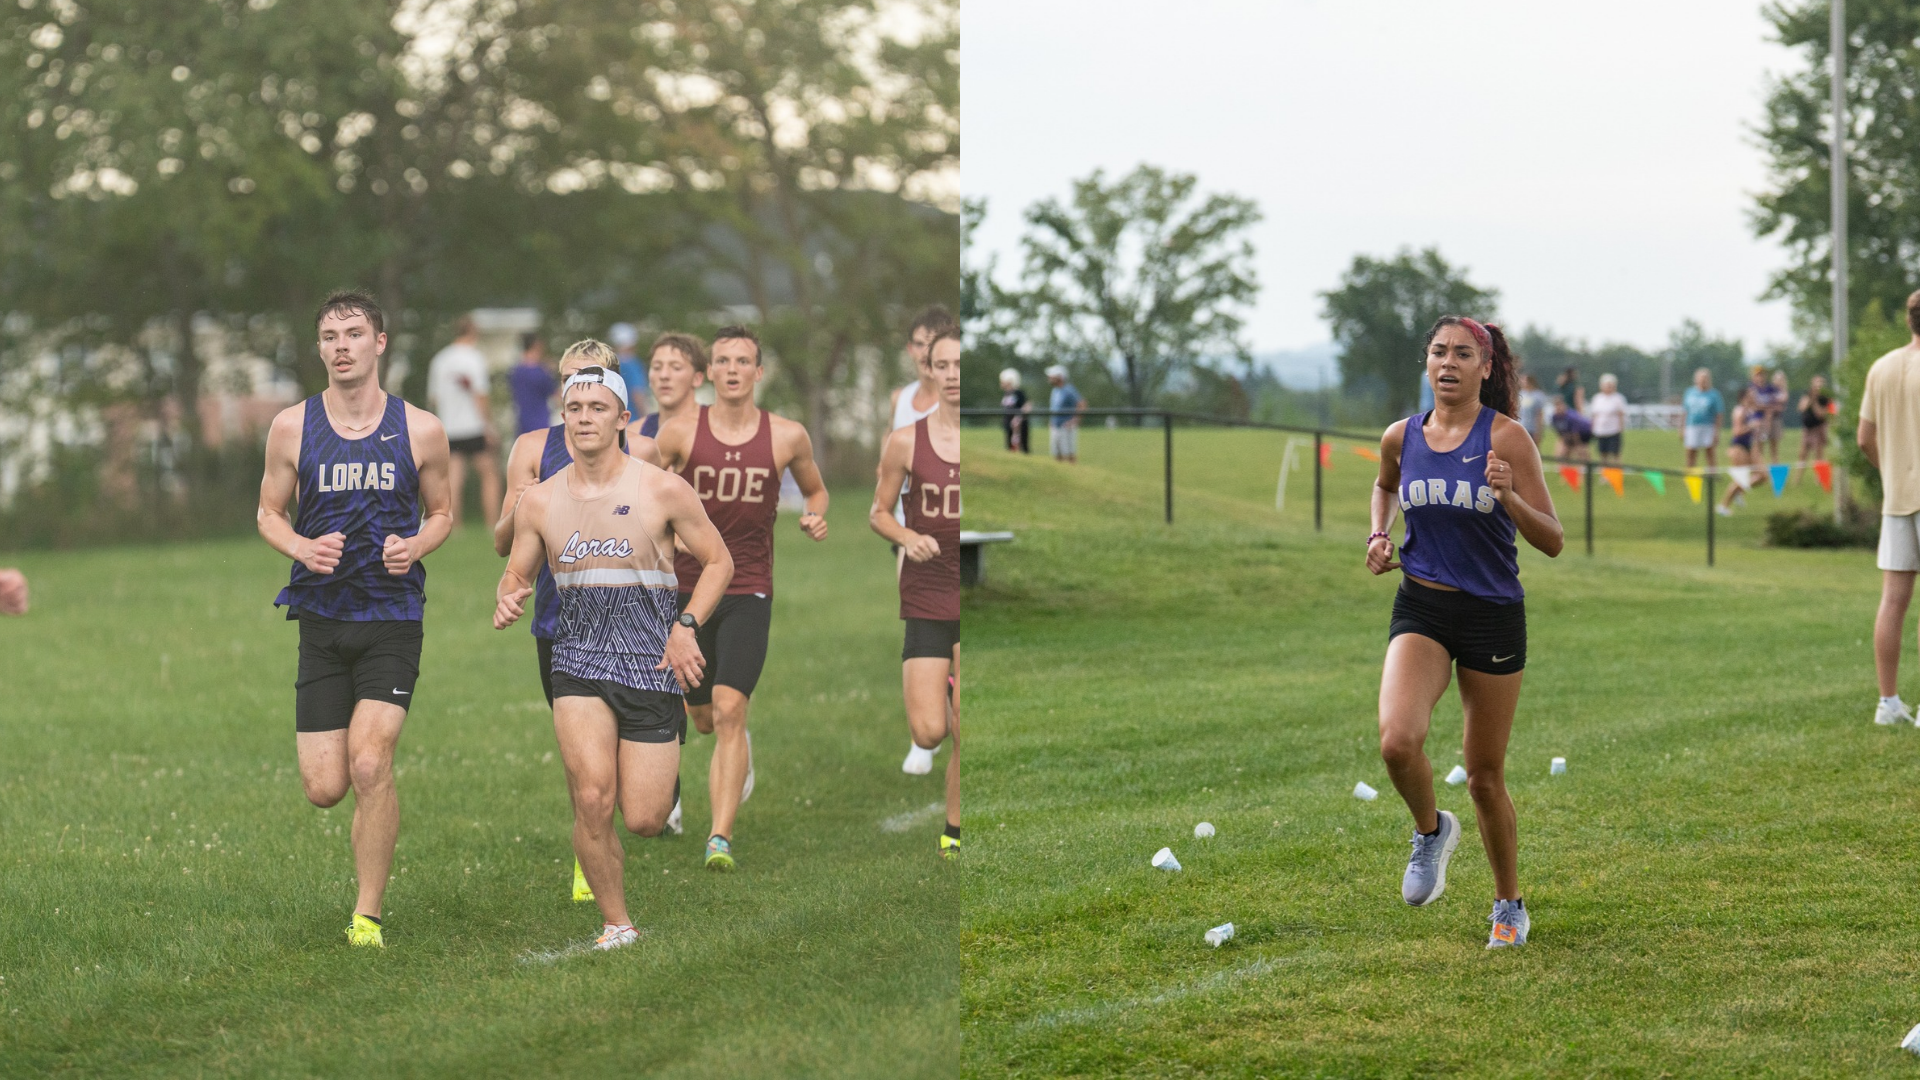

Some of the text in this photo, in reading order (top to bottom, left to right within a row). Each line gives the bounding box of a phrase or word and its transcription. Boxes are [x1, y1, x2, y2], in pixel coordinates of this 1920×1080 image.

[318, 462, 396, 492] LORAS
[693, 465, 770, 503] COE
[1398, 478, 1496, 514] LORAS
[558, 530, 633, 564] Loras
